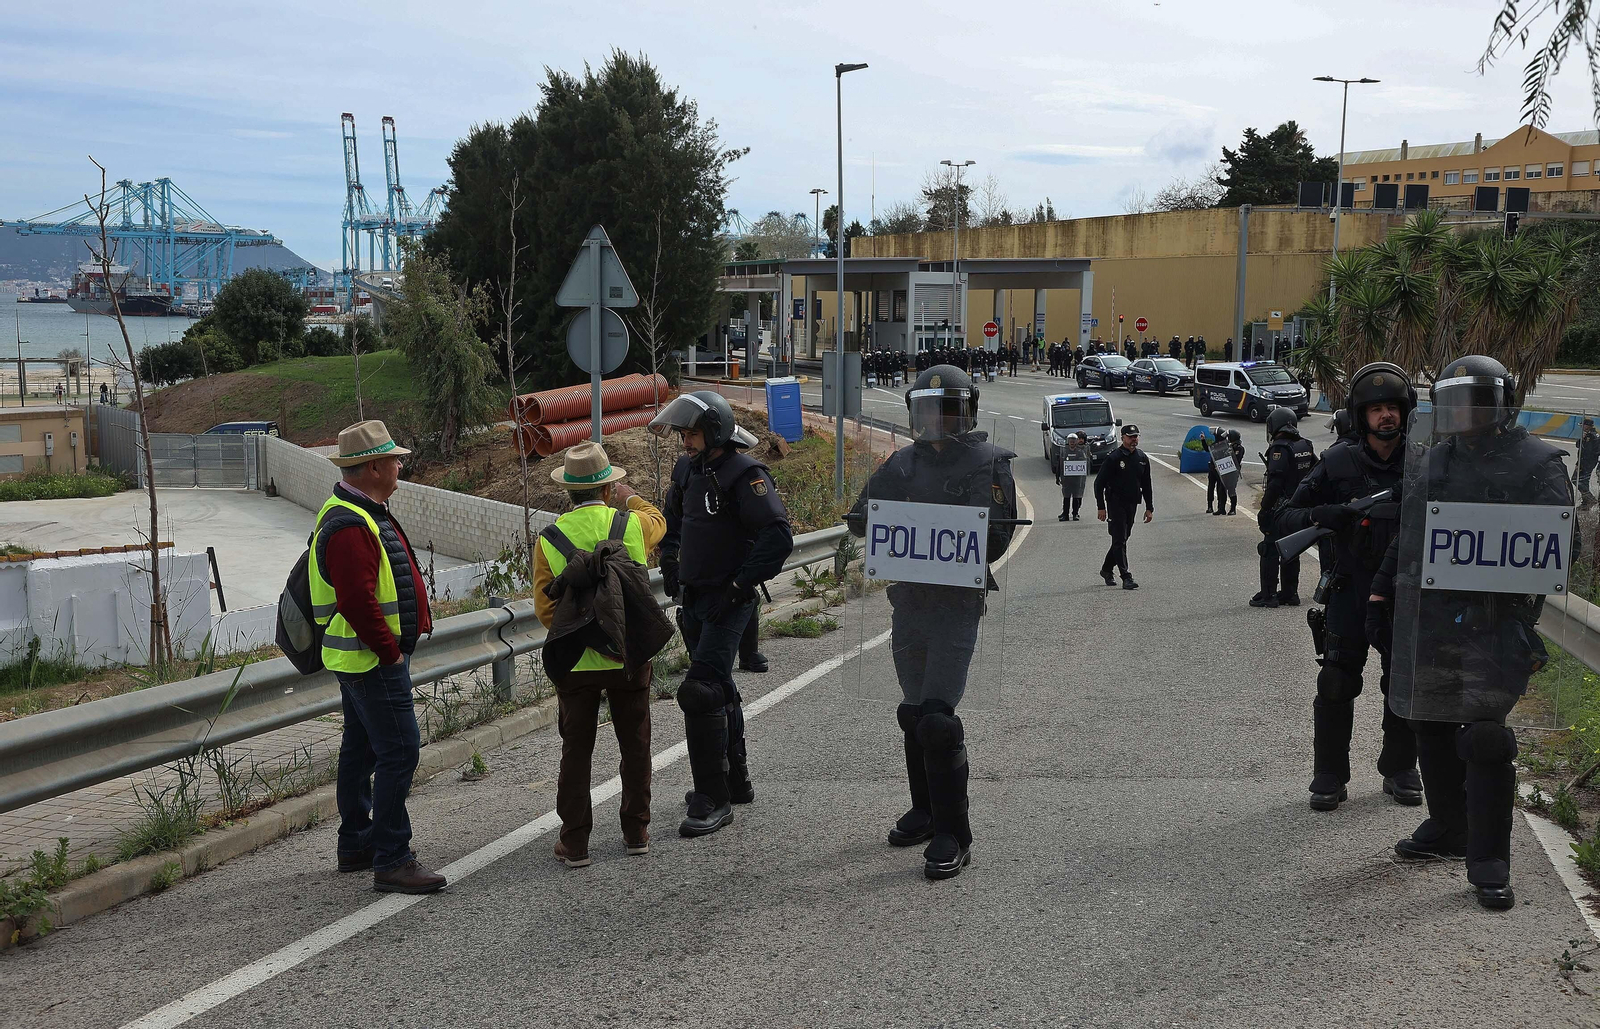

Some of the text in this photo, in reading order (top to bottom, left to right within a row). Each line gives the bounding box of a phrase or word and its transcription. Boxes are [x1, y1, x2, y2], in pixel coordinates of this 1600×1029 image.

[1065, 464, 1086, 472] POLICIA
[870, 523, 981, 564] POLICIA
[1429, 528, 1562, 570] POLICIA
